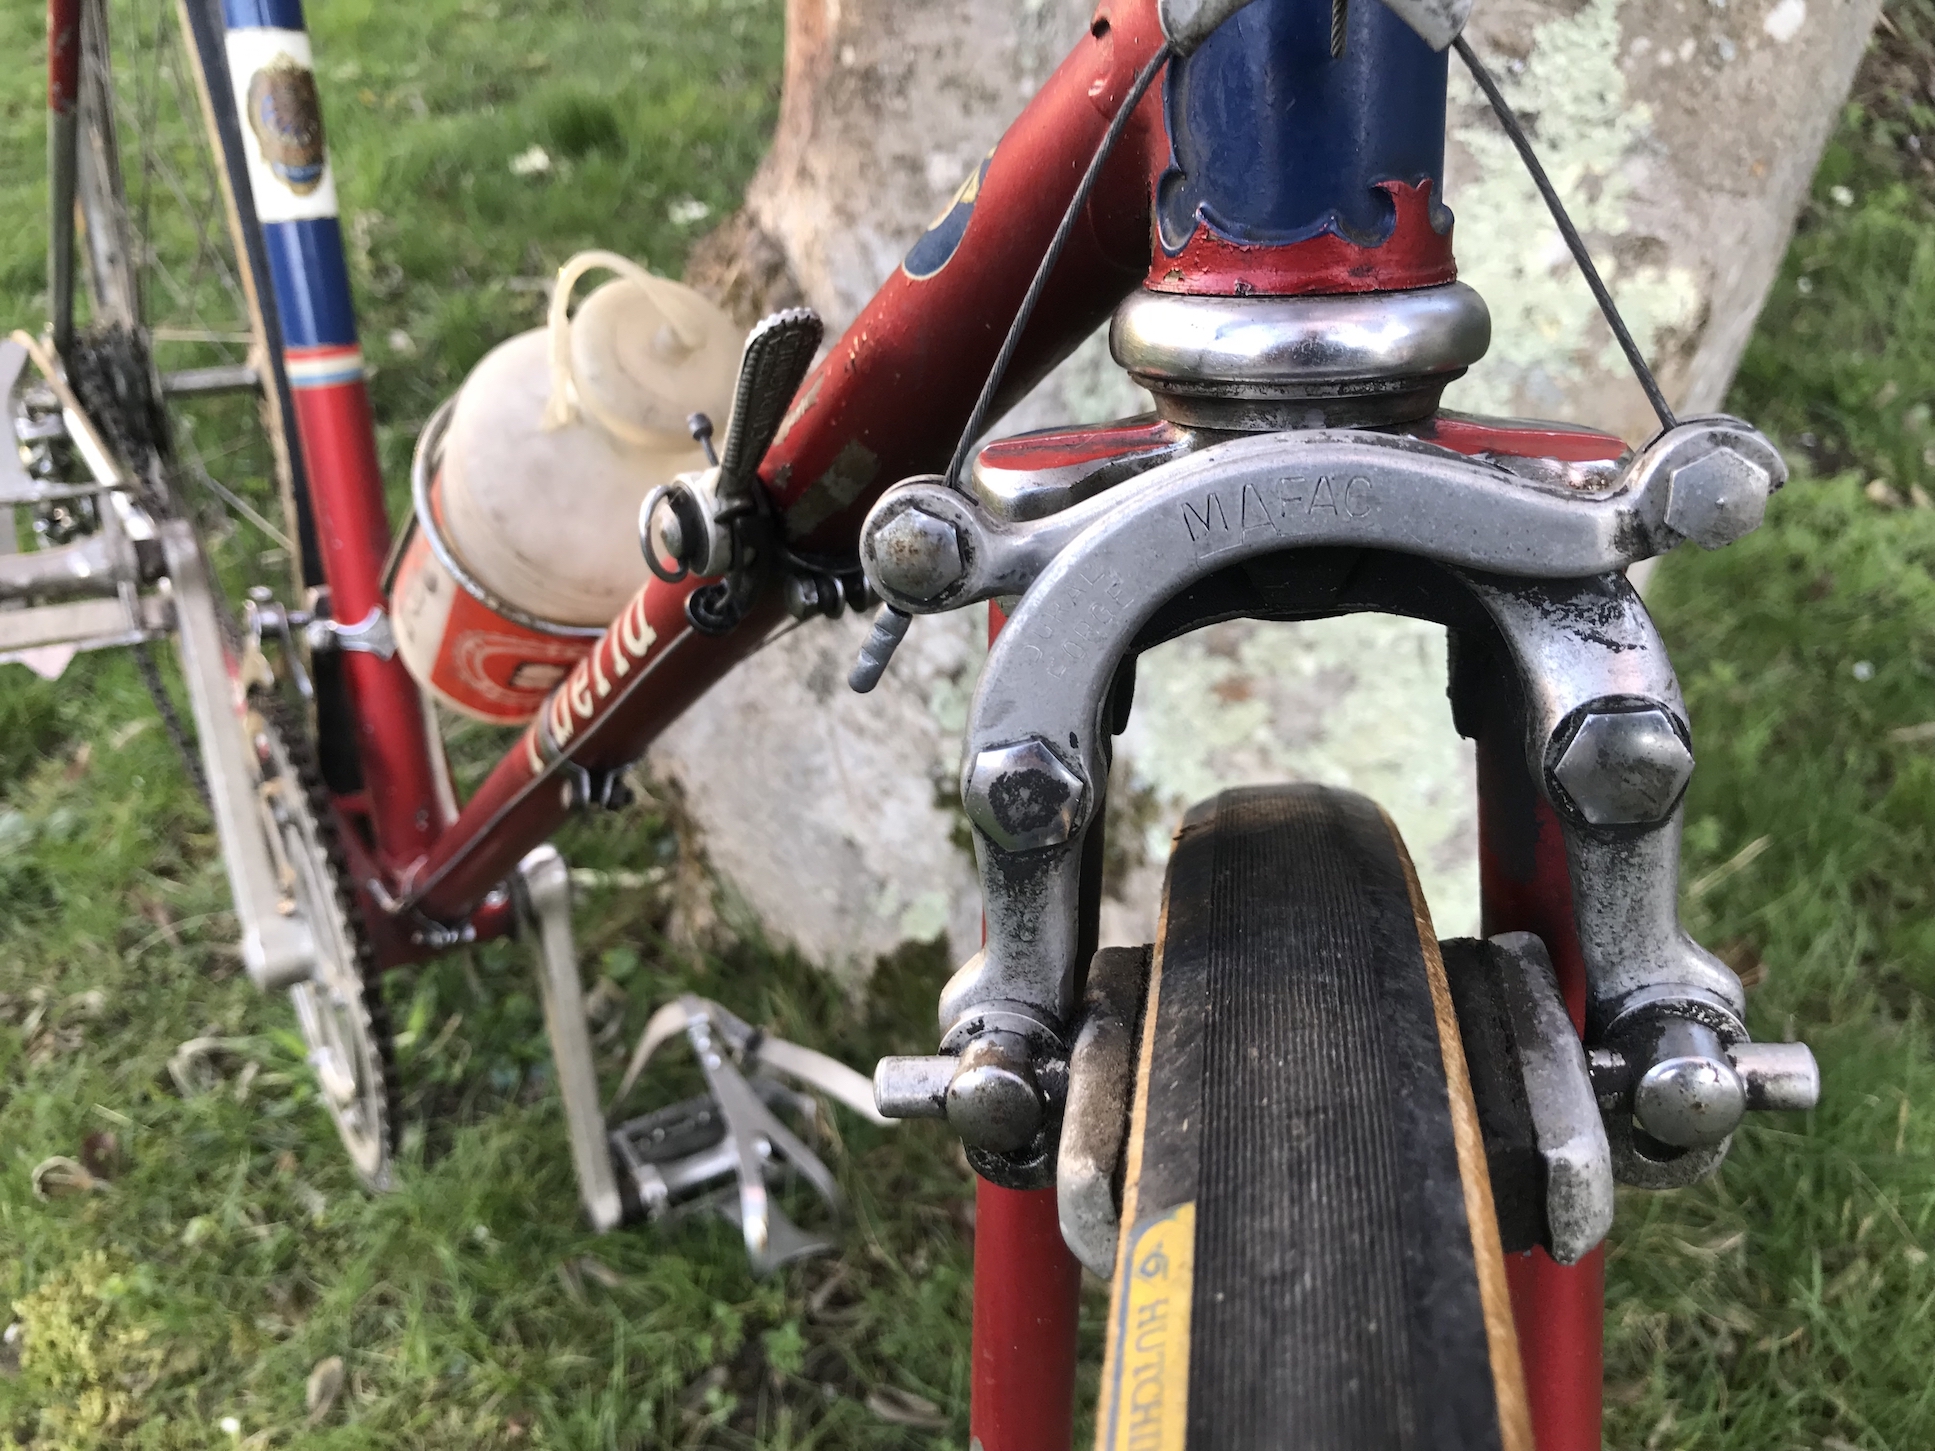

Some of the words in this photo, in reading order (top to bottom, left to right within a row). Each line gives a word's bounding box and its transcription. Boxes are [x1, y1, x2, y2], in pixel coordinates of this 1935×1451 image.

[1180, 475, 1373, 542] MAFAC
[1021, 571, 1105, 662] DURAL
[1128, 1297, 1169, 1451] HUTCHI
